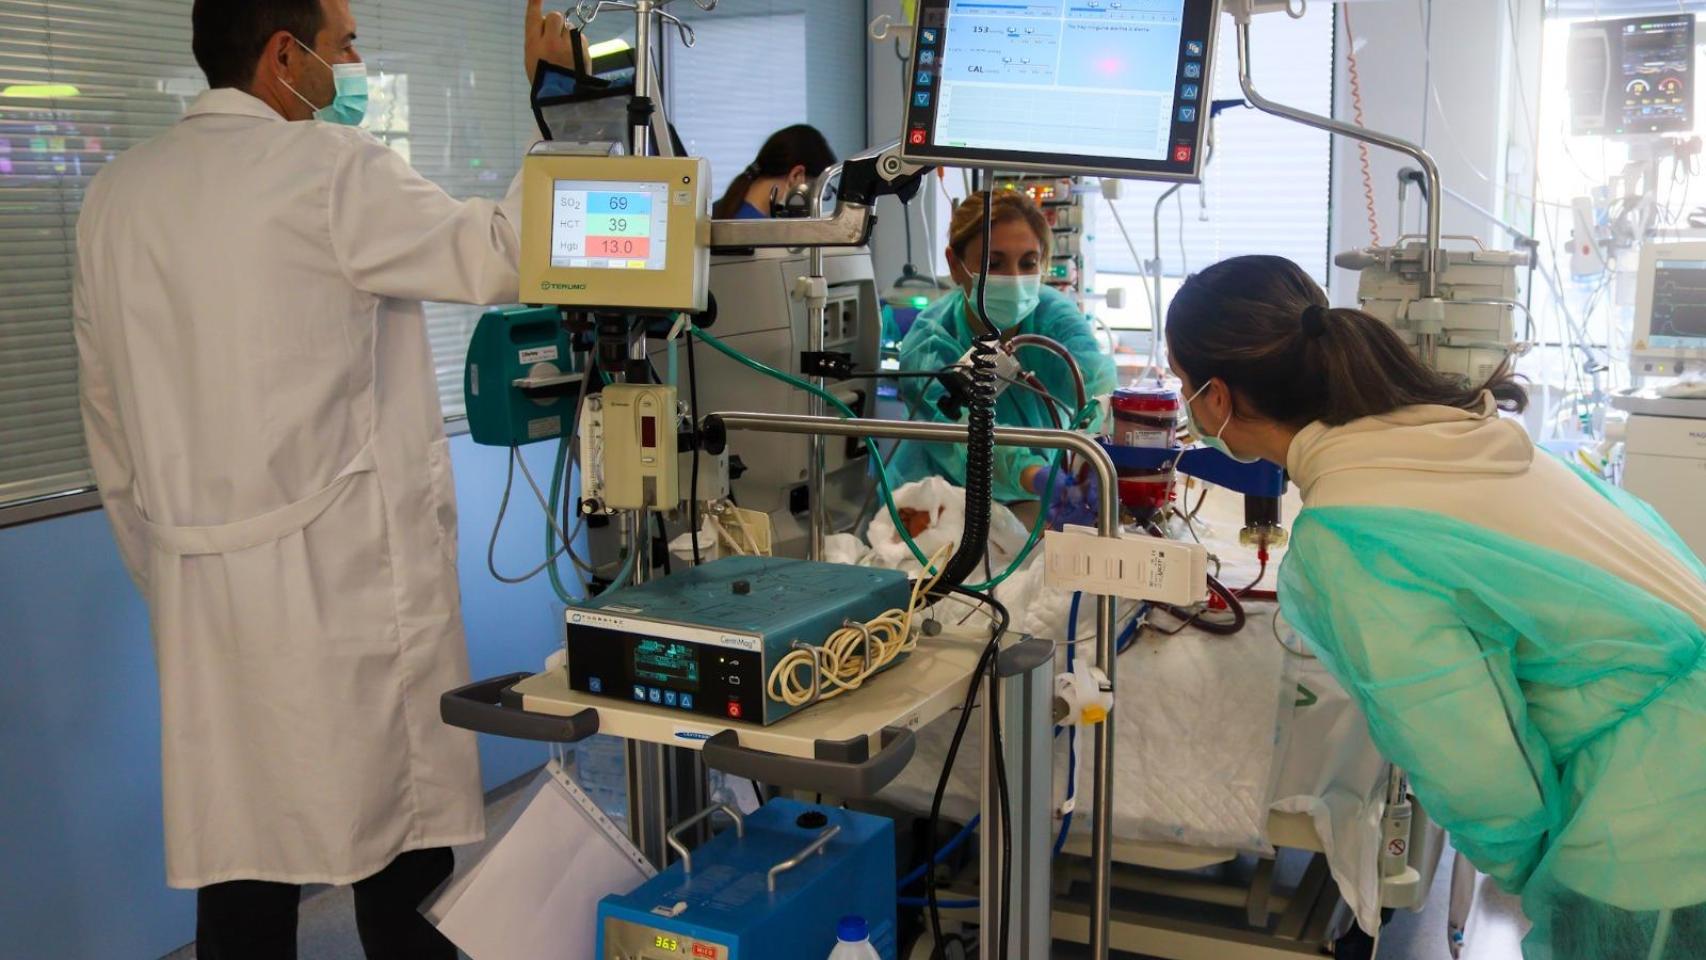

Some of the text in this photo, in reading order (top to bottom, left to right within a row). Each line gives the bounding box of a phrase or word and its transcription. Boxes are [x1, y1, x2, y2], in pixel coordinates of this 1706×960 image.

[967, 65, 984, 73] CAL
[609, 196, 628, 210] 69
[560, 217, 627, 232] HCT 39
[560, 240, 633, 254] Hgb 13.0
[551, 282, 587, 290] TERUMO
